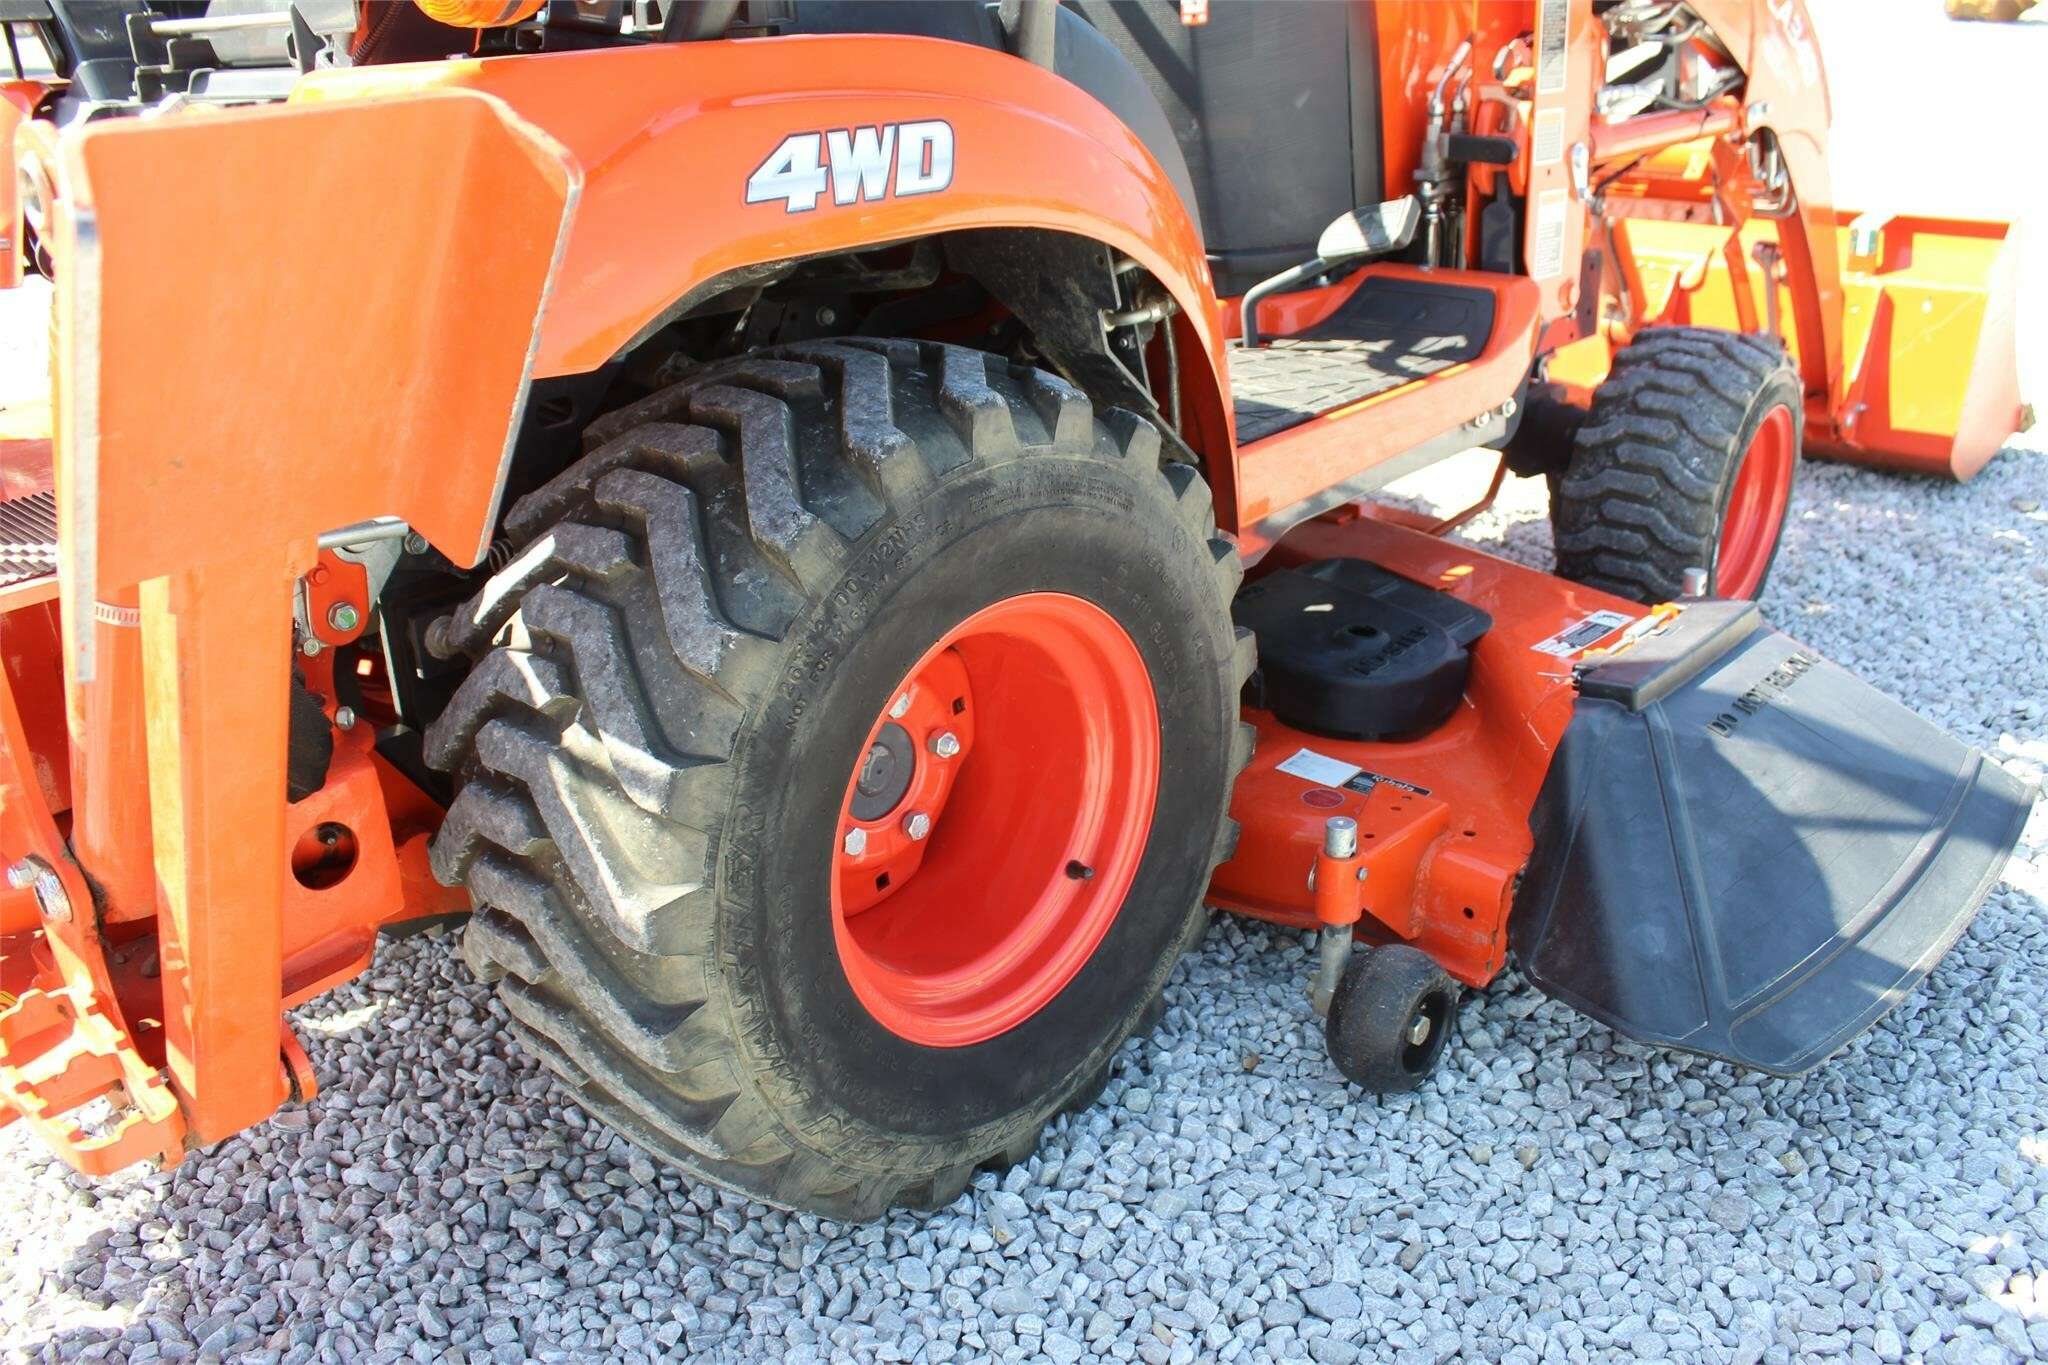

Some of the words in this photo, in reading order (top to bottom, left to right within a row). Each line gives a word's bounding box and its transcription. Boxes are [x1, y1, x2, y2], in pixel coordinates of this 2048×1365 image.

[745, 119, 955, 214] 4WD
[785, 693, 809, 729] NOT
[808, 648, 834, 684] FOR
[1706, 713, 1740, 738] DO
[1732, 684, 1773, 716] NOT
